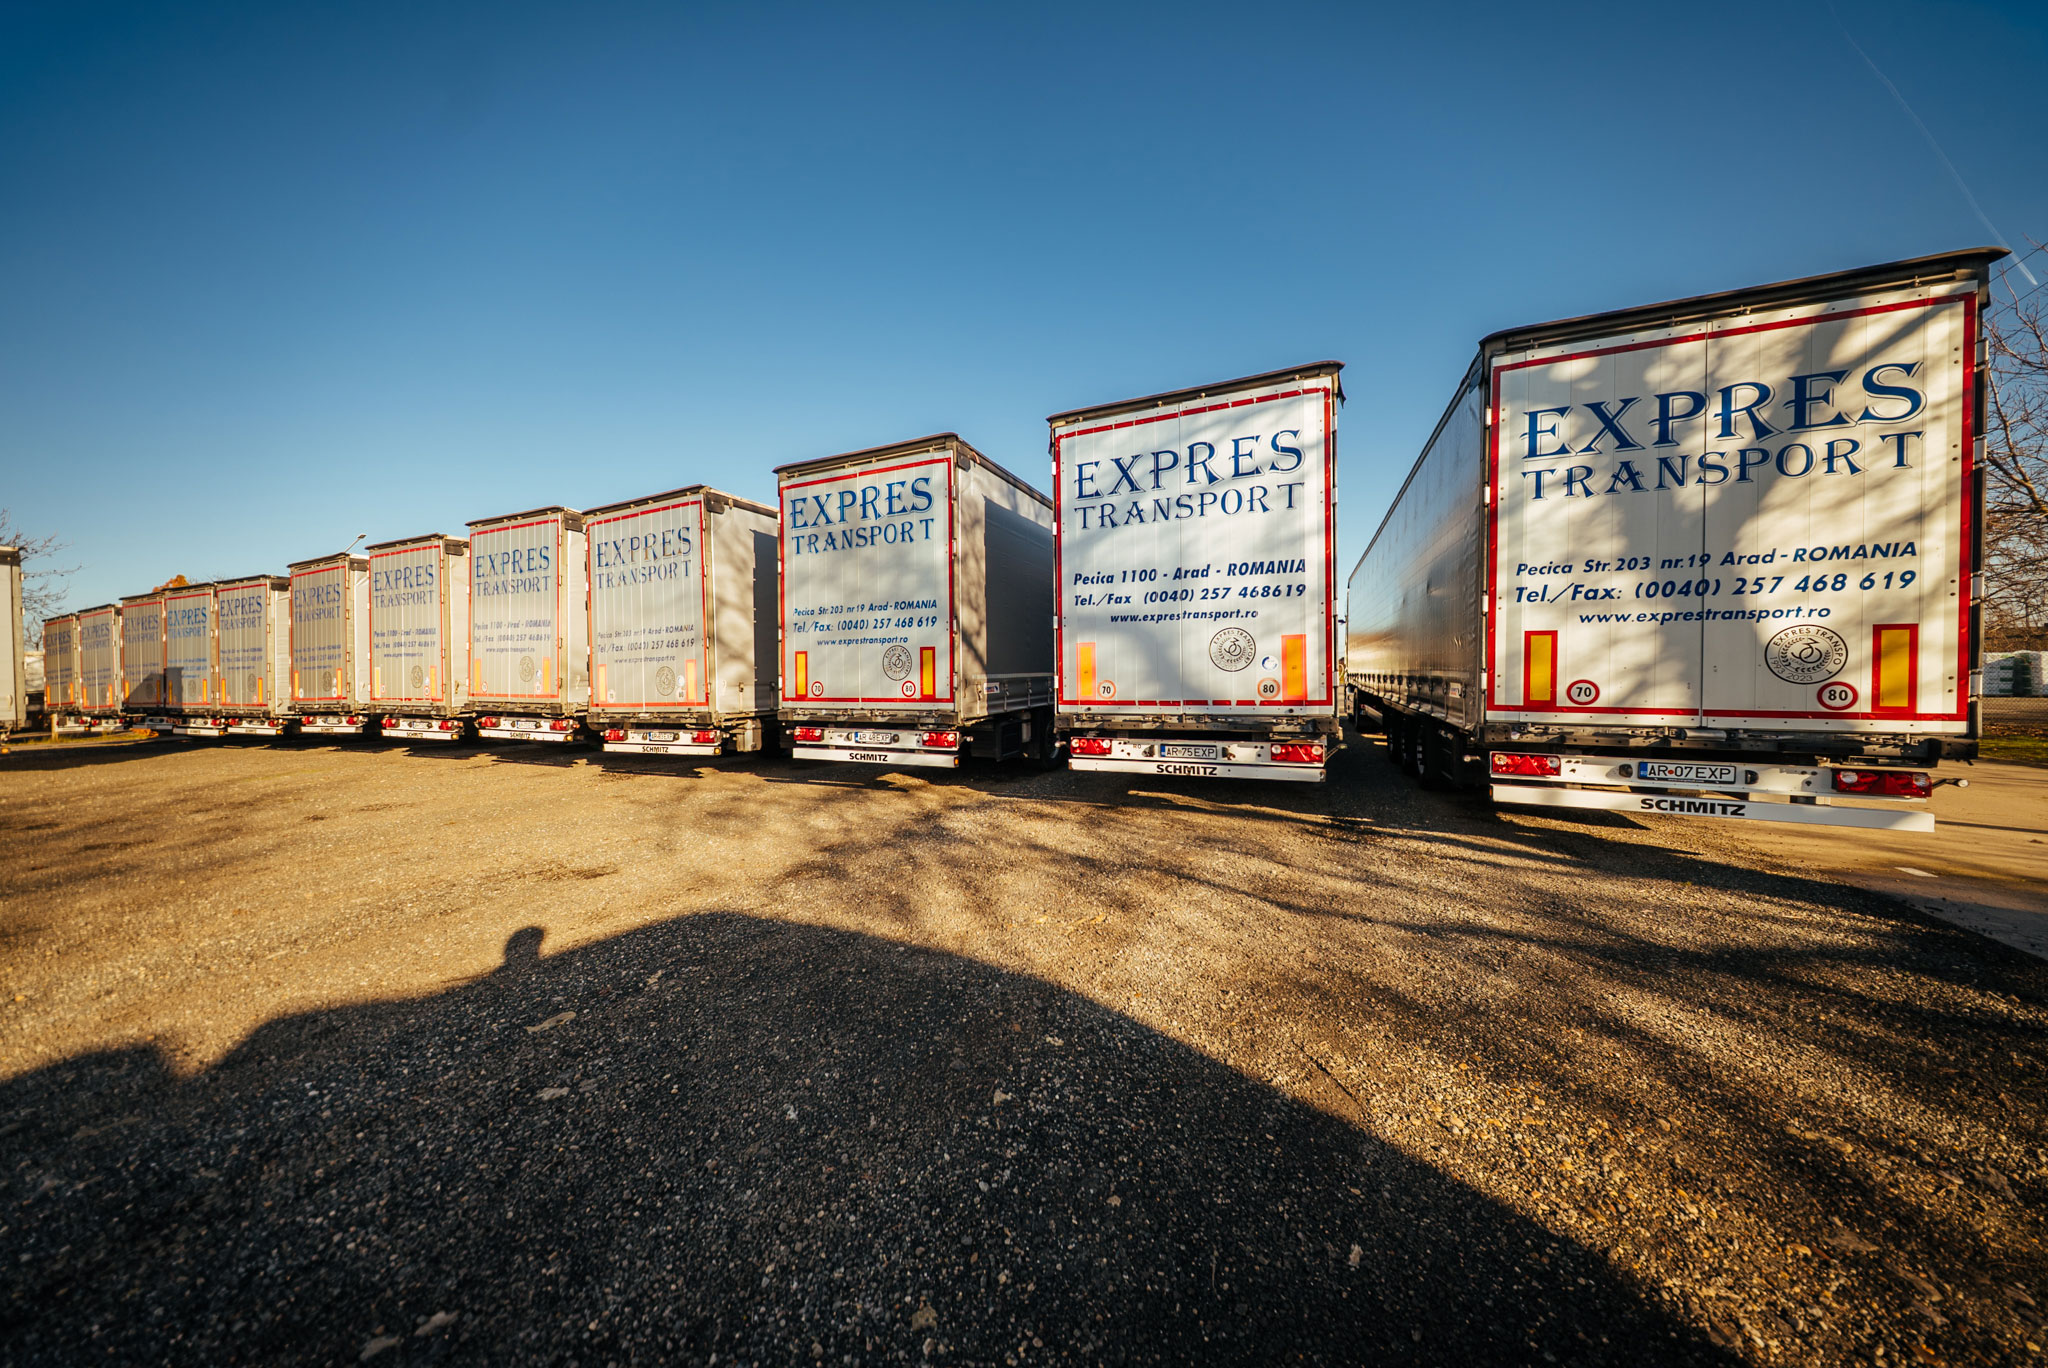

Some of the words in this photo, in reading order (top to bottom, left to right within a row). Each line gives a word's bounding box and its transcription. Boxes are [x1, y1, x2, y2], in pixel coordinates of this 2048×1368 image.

[1520, 361, 1928, 460] EXPRES
[1074, 429, 1306, 500] EXPRES
[1521, 431, 1926, 501] TRANSPORT
[790, 477, 934, 530] EXPRES
[1074, 482, 1305, 530] TRANSPORT
[791, 518, 934, 555] TRANSPORT
[596, 526, 693, 569] EXPRES
[475, 545, 550, 578] EXPRES
[1515, 561, 1573, 576] Pecica
[1793, 541, 1917, 563] ROMANIA
[373, 564, 434, 592] EXPRES
[596, 559, 692, 590] TRANSPORT
[1073, 571, 1114, 586] Pecica
[1121, 568, 1157, 583] 1100
[1172, 563, 1211, 581] Arad
[1227, 558, 1306, 577] ROMANIA
[294, 583, 341, 607] EXPRES
[475, 575, 551, 597] TRANSPORT
[1074, 592, 1132, 607] Tel./Fax
[1143, 588, 1194, 605] (0040)
[1200, 586, 1231, 600] 257
[1238, 583, 1306, 599] 468619
[1515, 582, 1622, 604] Tel./Fax:
[1635, 578, 1721, 599] (0040)
[1731, 576, 1784, 595] 257
[1794, 573, 1847, 592] 468
[1859, 570, 1917, 590] 619
[220, 596, 262, 617] EXPRES
[374, 589, 434, 609] TRANSPORT
[168, 607, 207, 626] EXPRES
[837, 619, 869, 631] (0040)
[873, 617, 891, 629] 257
[894, 616, 914, 628] 468
[917, 615, 937, 628] 619
[1110, 608, 1258, 624] www.exprestransport.ro
[1579, 606, 1831, 625] www.exprestransport.ro
[651, 640, 664, 650] 257
[666, 639, 679, 649] 468
[681, 638, 695, 647] 619
[1773, 627, 1811, 647] EXPRES
[1815, 629, 1844, 675] TRANSPOT
[814, 684, 821, 693] 70
[906, 685, 913, 693] 80
[1102, 685, 1111, 695] 70
[1262, 684, 1275, 694] 80
[1575, 687, 1592, 698] 70
[1828, 689, 1848, 701] 80
[642, 745, 669, 753] SCHMITZ
[849, 752, 888, 762] SCHMITZ
[1156, 764, 1218, 776] SCHMITZ
[1640, 798, 1746, 817] SCHMITZ
